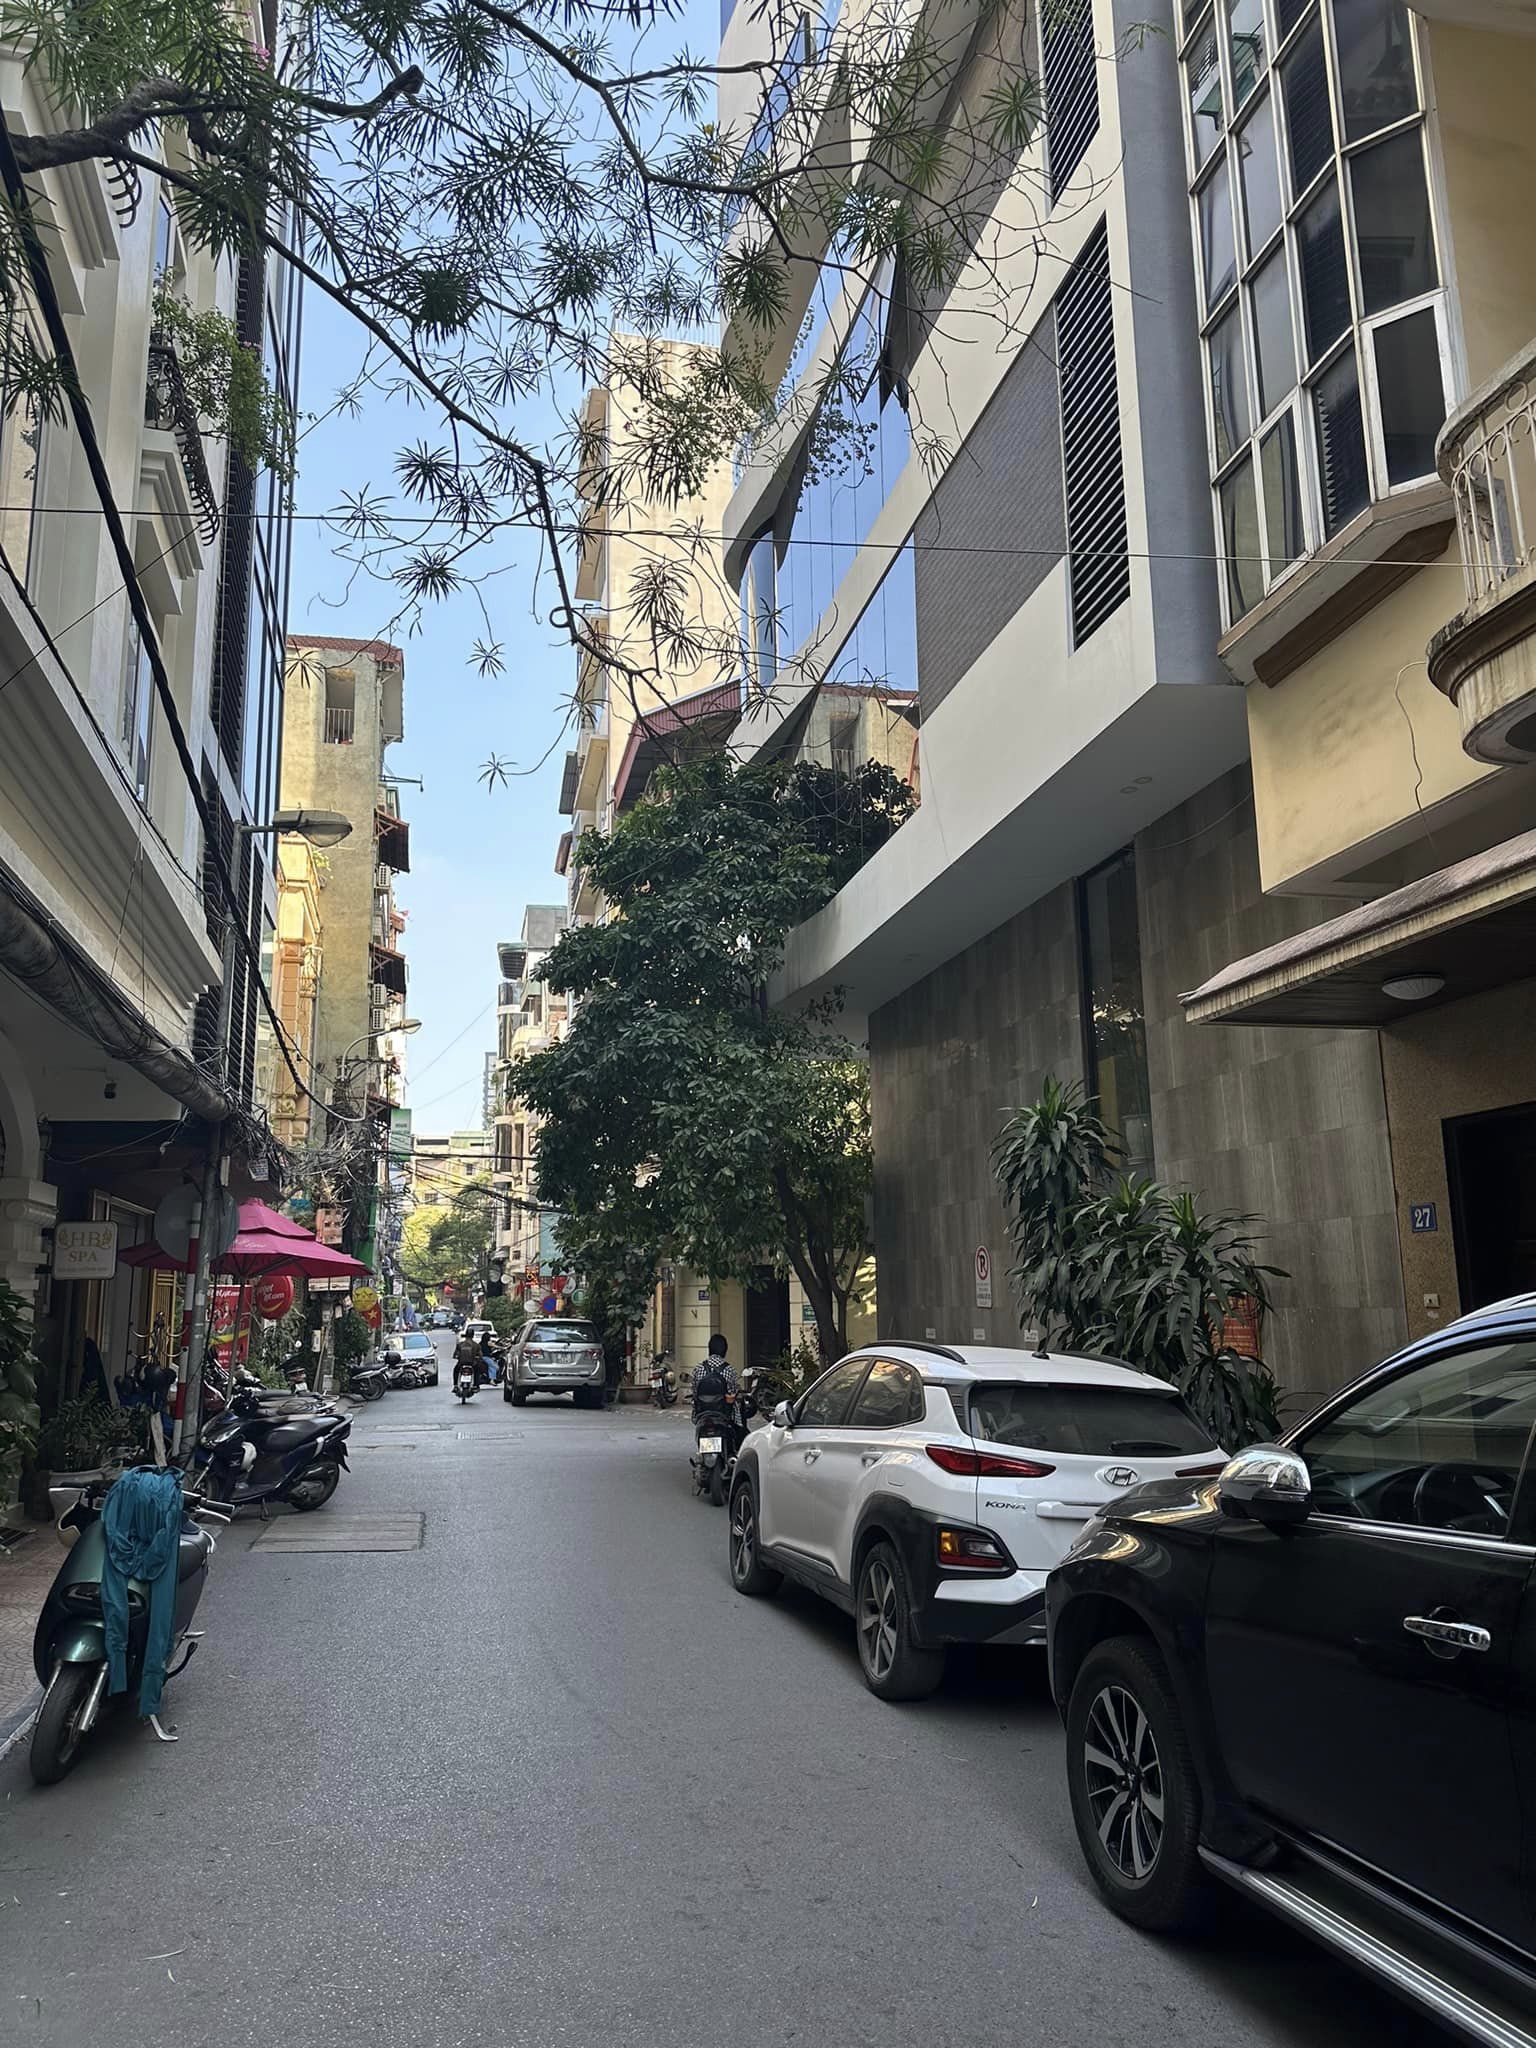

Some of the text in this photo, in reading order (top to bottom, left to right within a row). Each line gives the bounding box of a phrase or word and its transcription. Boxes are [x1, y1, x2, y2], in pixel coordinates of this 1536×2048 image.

[1414, 1207, 1431, 1228] 27
[68, 1250, 97, 1262] SPA
[985, 1501, 1027, 1511] KONA
